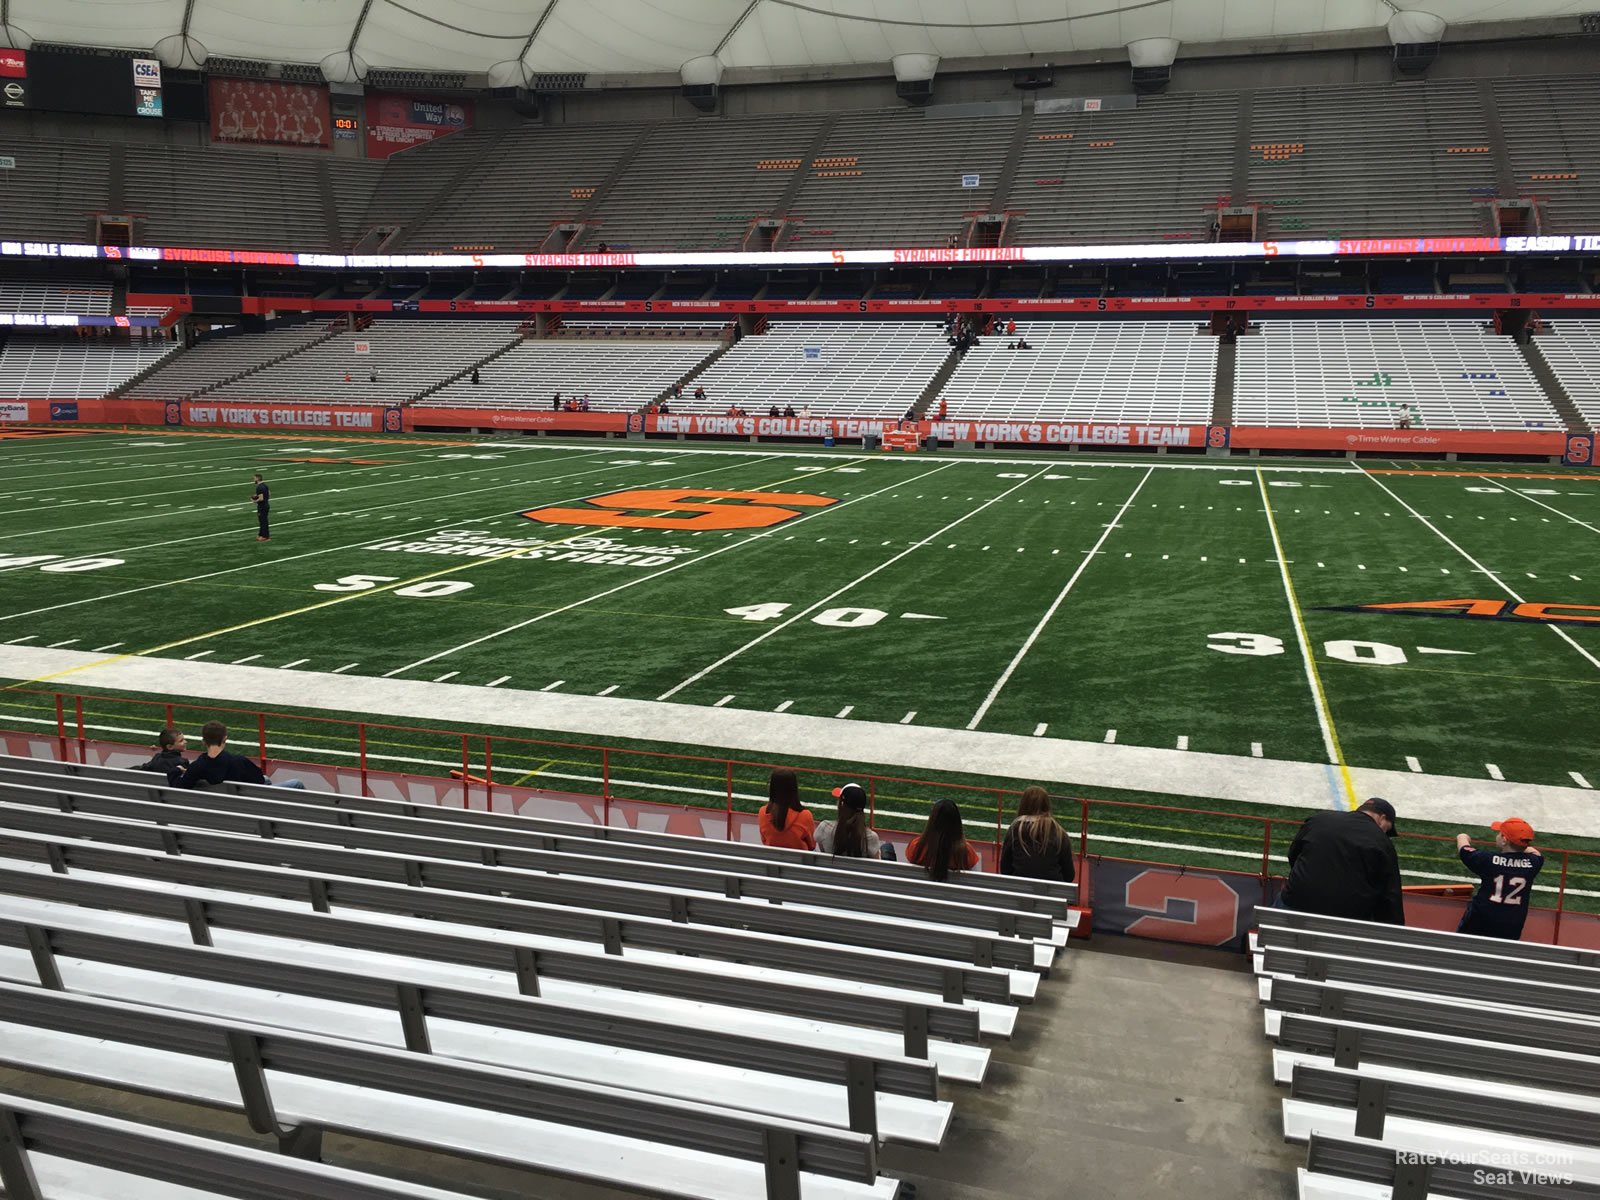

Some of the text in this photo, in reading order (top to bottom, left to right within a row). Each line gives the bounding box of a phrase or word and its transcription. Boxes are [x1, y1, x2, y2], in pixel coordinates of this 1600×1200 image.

[135, 64, 158, 77] CSEA
[137, 107, 162, 115] CROUSE
[413, 102, 443, 114] United
[336, 119, 357, 129] 10:01
[425, 113, 443, 126] Way
[24, 243, 58, 256] SALE
[1337, 239, 1419, 255] SYRACUSE
[1422, 236, 1500, 253] FOOTBALL
[1505, 235, 1570, 251] SEASON
[162, 248, 231, 263] SYRACUSE
[523, 253, 635, 267] SYRACUSE FOOTBALL
[892, 247, 1024, 263] SYRACUSE FOOTBALL
[166, 404, 180, 424] S
[189, 407, 374, 428] NEW YORK'S COLLEGE TEAM
[386, 410, 401, 431] S
[629, 415, 643, 432] S
[656, 415, 884, 439] NEW YORK'S COLLEGE TEAM
[929, 421, 1190, 447] NEW YORK'S COLLEGE TEAM
[1208, 426, 1226, 448] S
[1359, 434, 1438, 444] Time Warner Cable
[1566, 436, 1591, 463] S
[360, 540, 676, 568] LEGENDS FIELD
[1492, 855, 1533, 868] ORANGE
[1489, 874, 1527, 905] 12
